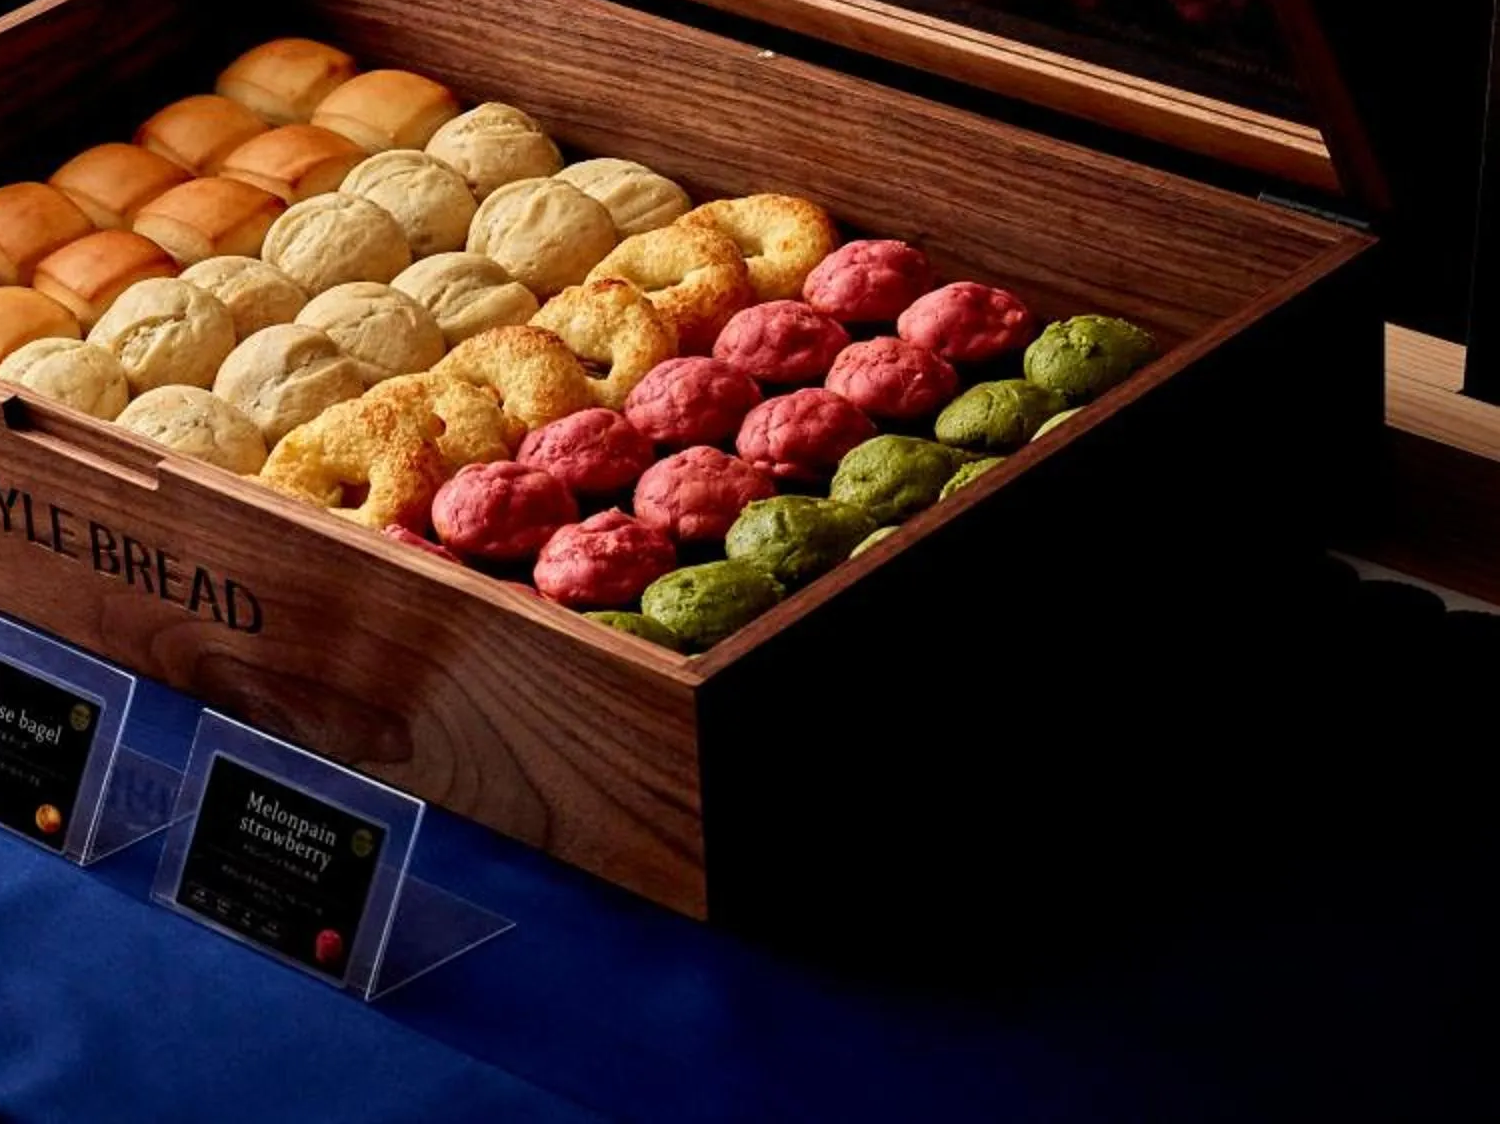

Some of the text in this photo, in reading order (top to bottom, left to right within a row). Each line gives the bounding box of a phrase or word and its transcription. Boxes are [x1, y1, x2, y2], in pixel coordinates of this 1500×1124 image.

[89, 520, 264, 635] BREAD
[18, 709, 63, 745] bagel
[239, 816, 332, 872] strawberry
[247, 791, 337, 847] Melonpain
